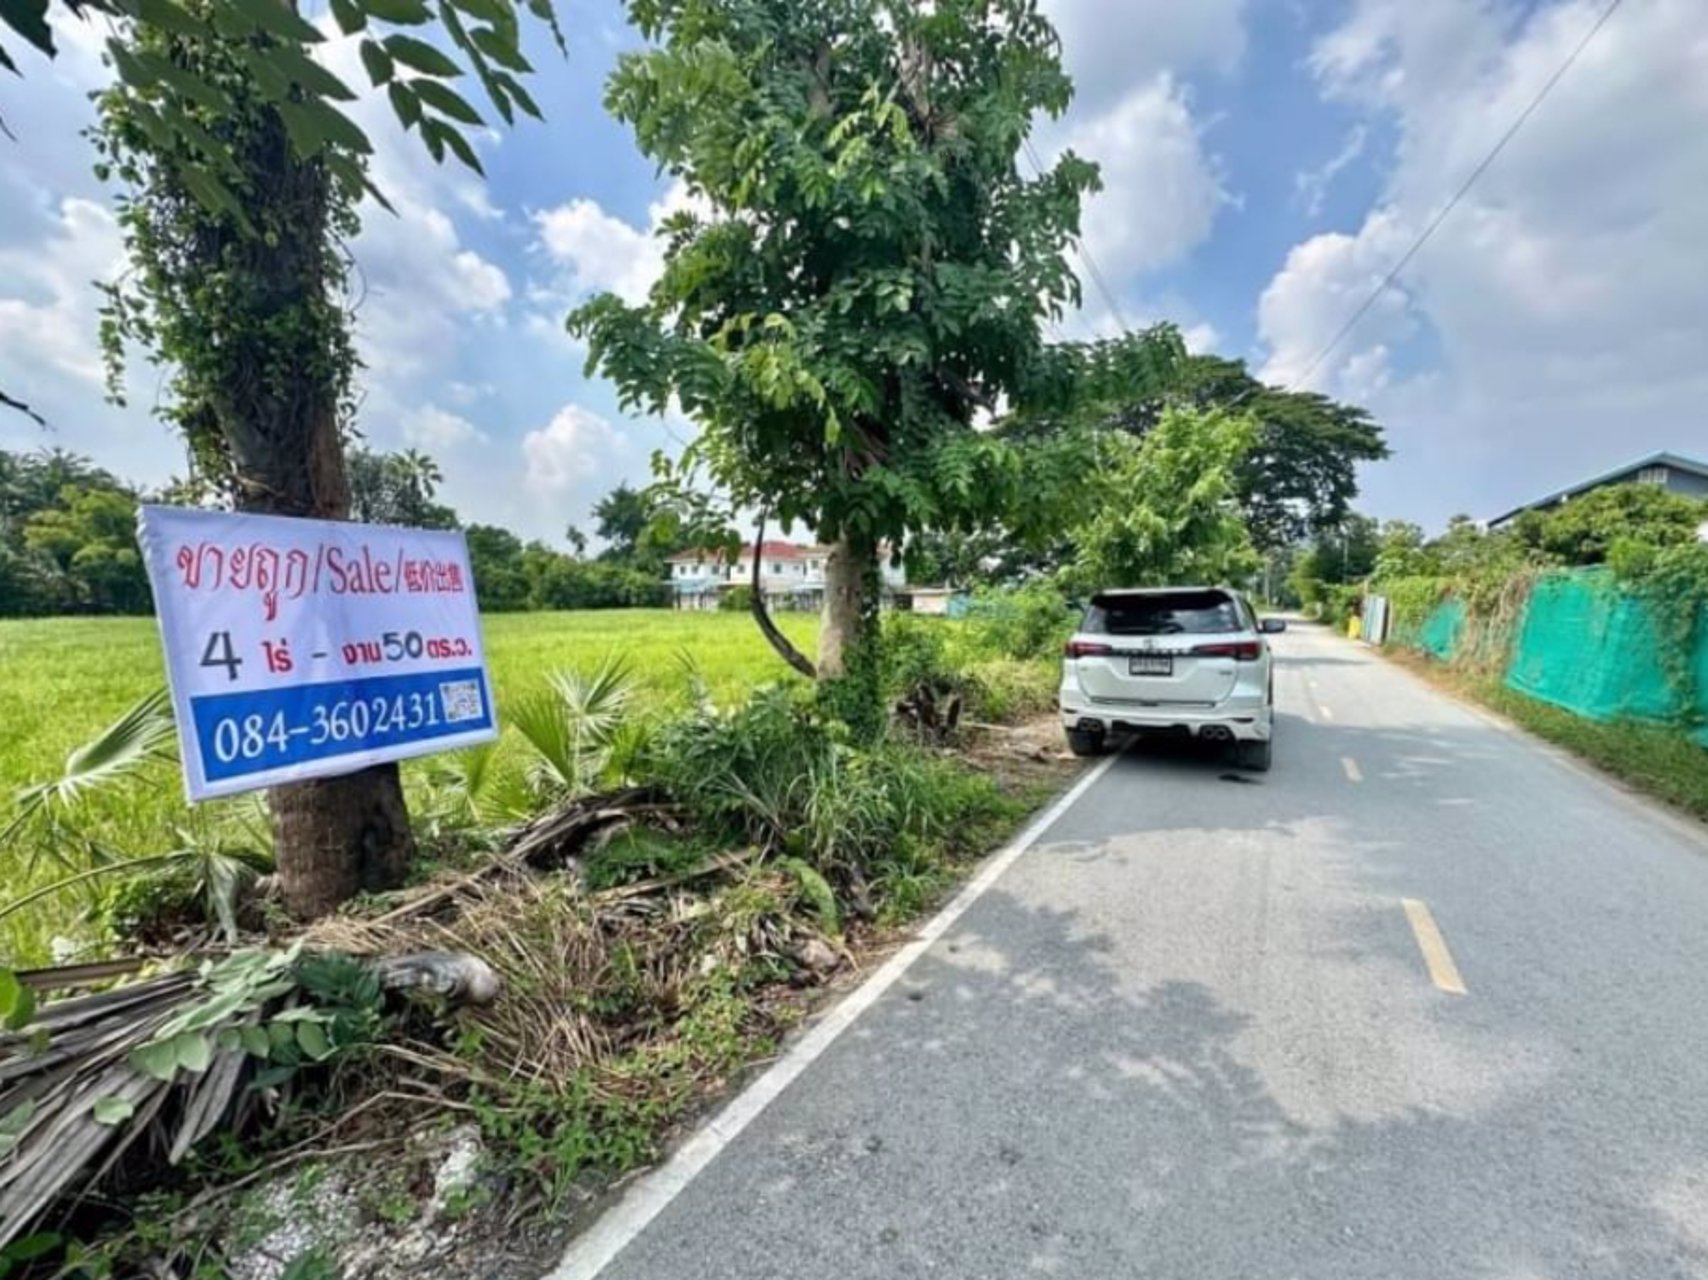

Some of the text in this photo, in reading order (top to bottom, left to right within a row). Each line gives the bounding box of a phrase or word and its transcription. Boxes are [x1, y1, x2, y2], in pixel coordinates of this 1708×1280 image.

[200, 631, 243, 681] 4
[261, 637, 293, 673] ไร่
[382, 631, 423, 661] 50
[214, 691, 440, 762] 084-3602431
